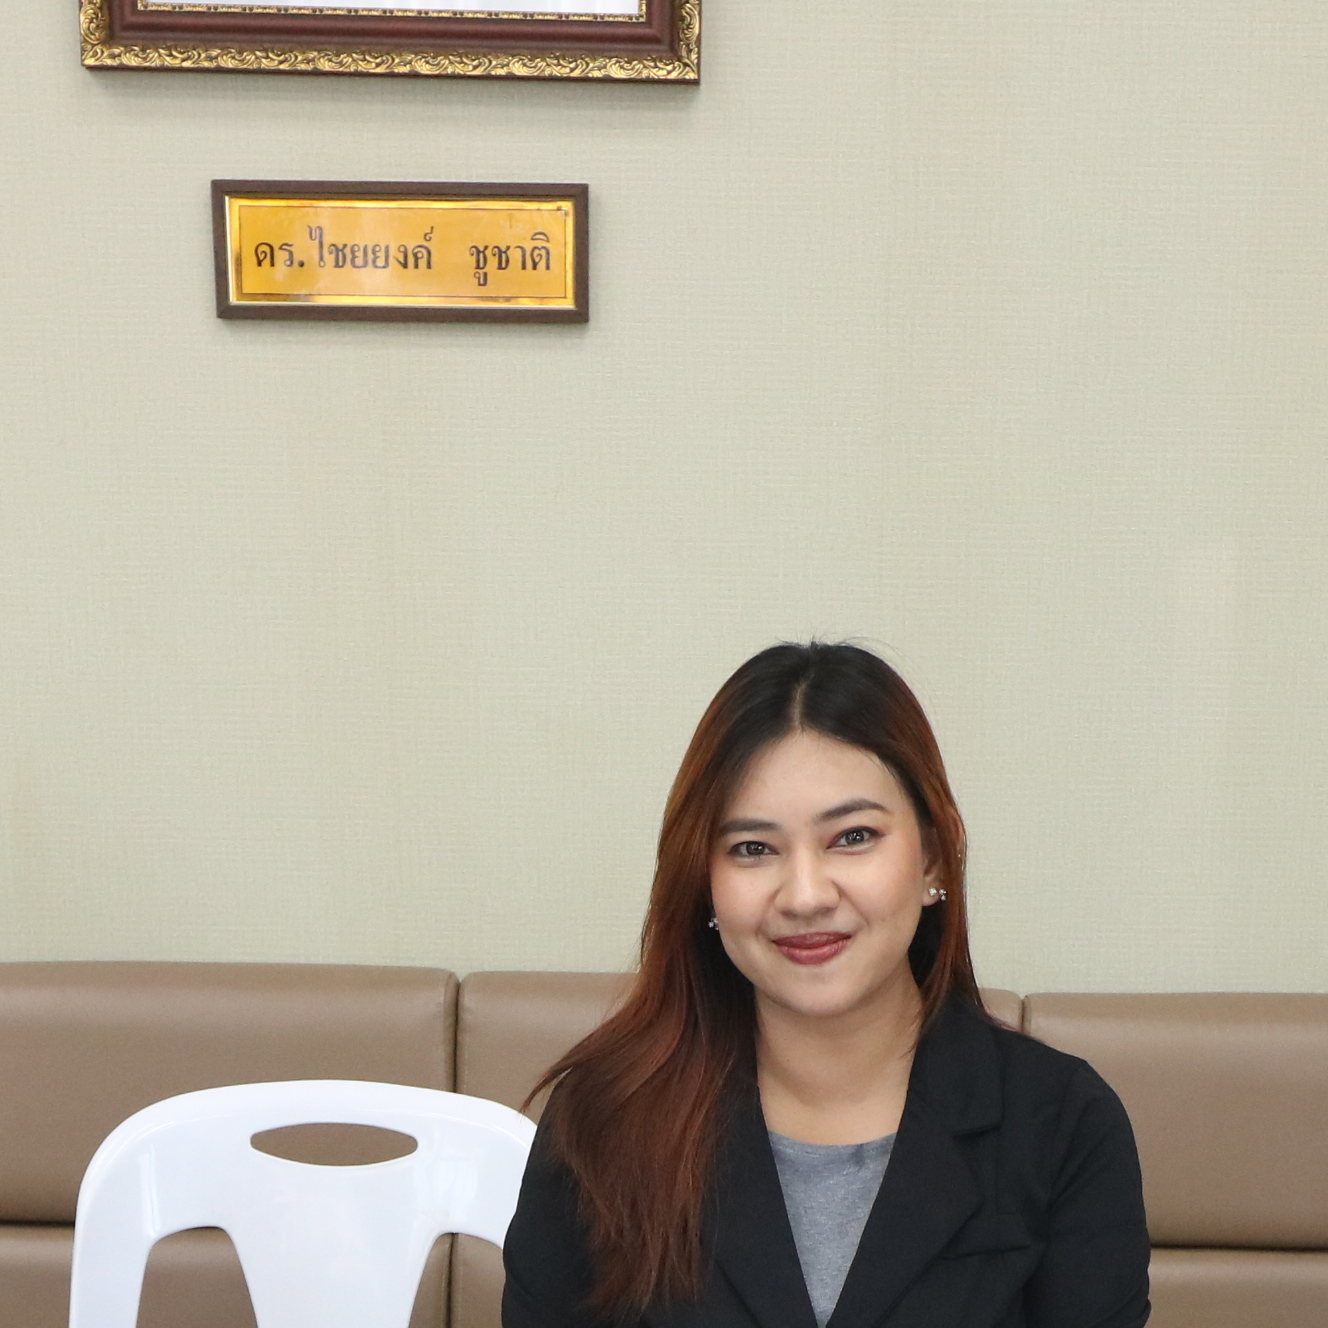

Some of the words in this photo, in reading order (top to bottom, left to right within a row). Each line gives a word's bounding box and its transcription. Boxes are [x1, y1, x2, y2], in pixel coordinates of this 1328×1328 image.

[255, 225, 434, 270] ดร.ไชยยงค์
[469, 232, 551, 286] ชูชาติ
